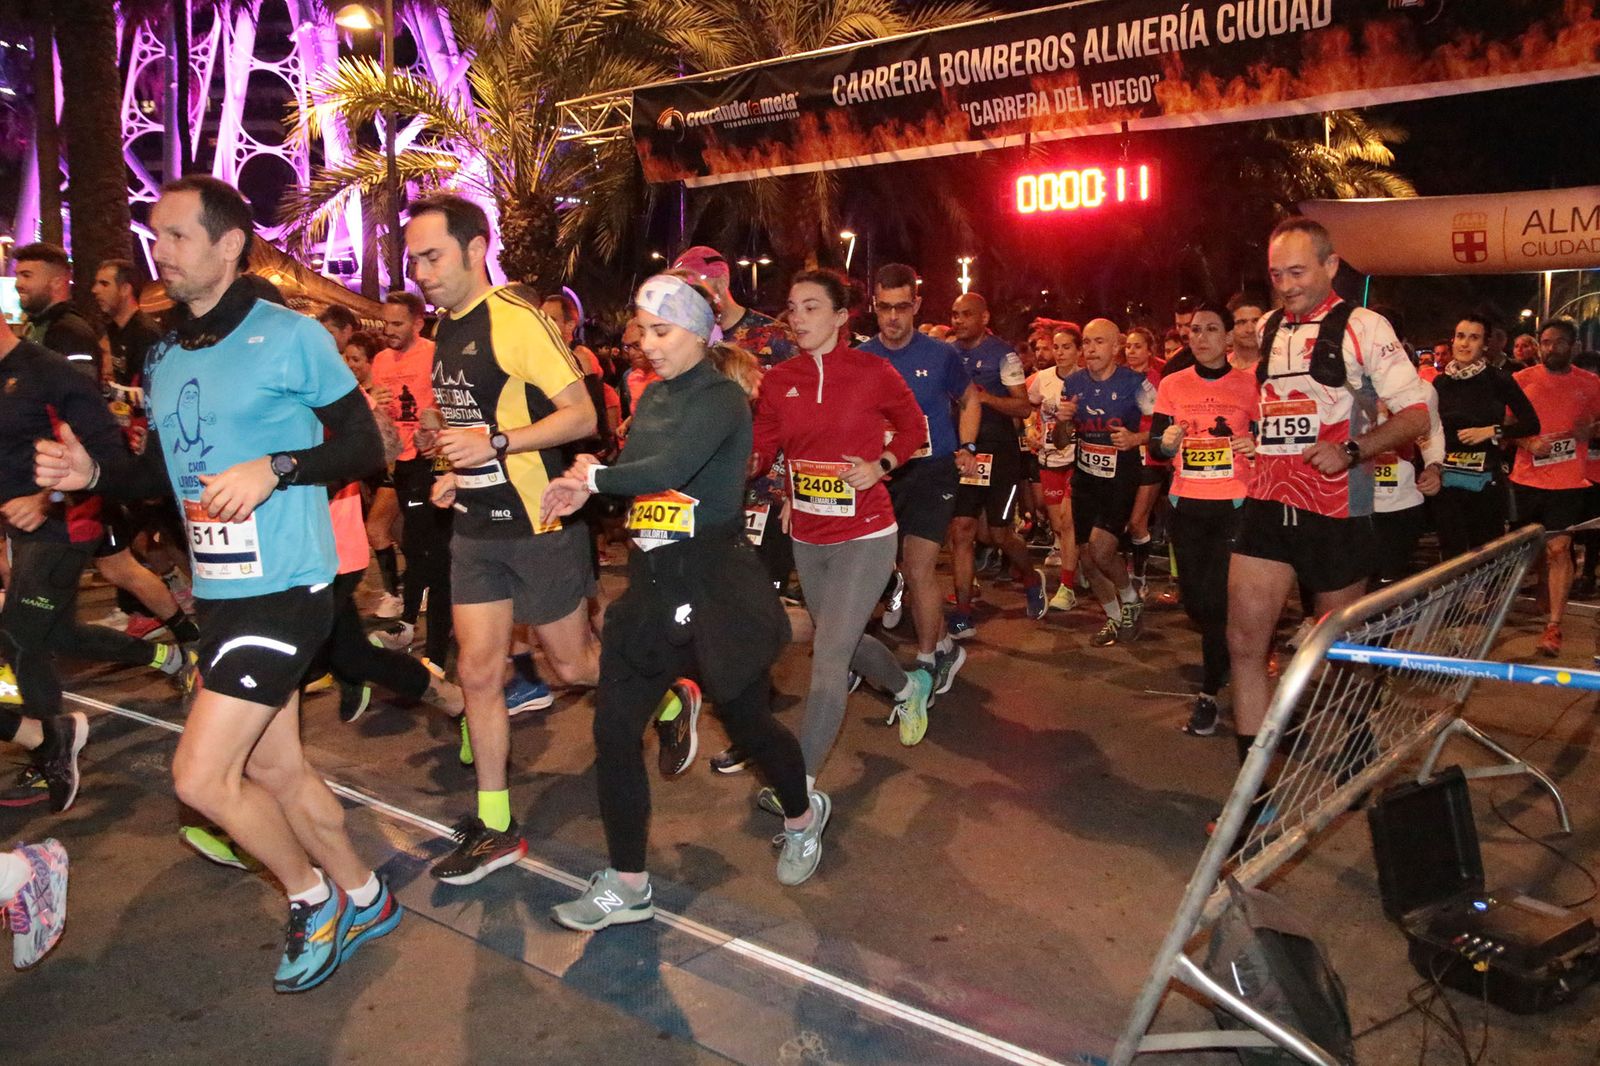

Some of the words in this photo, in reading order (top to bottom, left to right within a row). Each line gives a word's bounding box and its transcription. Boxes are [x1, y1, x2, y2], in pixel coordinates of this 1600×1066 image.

[832, 57, 936, 106] CARRERA
[940, 32, 1077, 88] BOMBEROS
[1083, 3, 1210, 66] ALMERÍA
[1216, 0, 1332, 44] CIUDAD
[1054, 85, 1089, 114] DEL
[441, 405, 483, 420] SEBASTIAN
[1272, 416, 1311, 436] 159
[1084, 453, 1111, 467] 195
[1190, 450, 1225, 462] 2237
[802, 476, 845, 494] 2408
[491, 509, 512, 518] IMQ
[635, 504, 681, 524] 2407
[192, 525, 230, 546] 511
